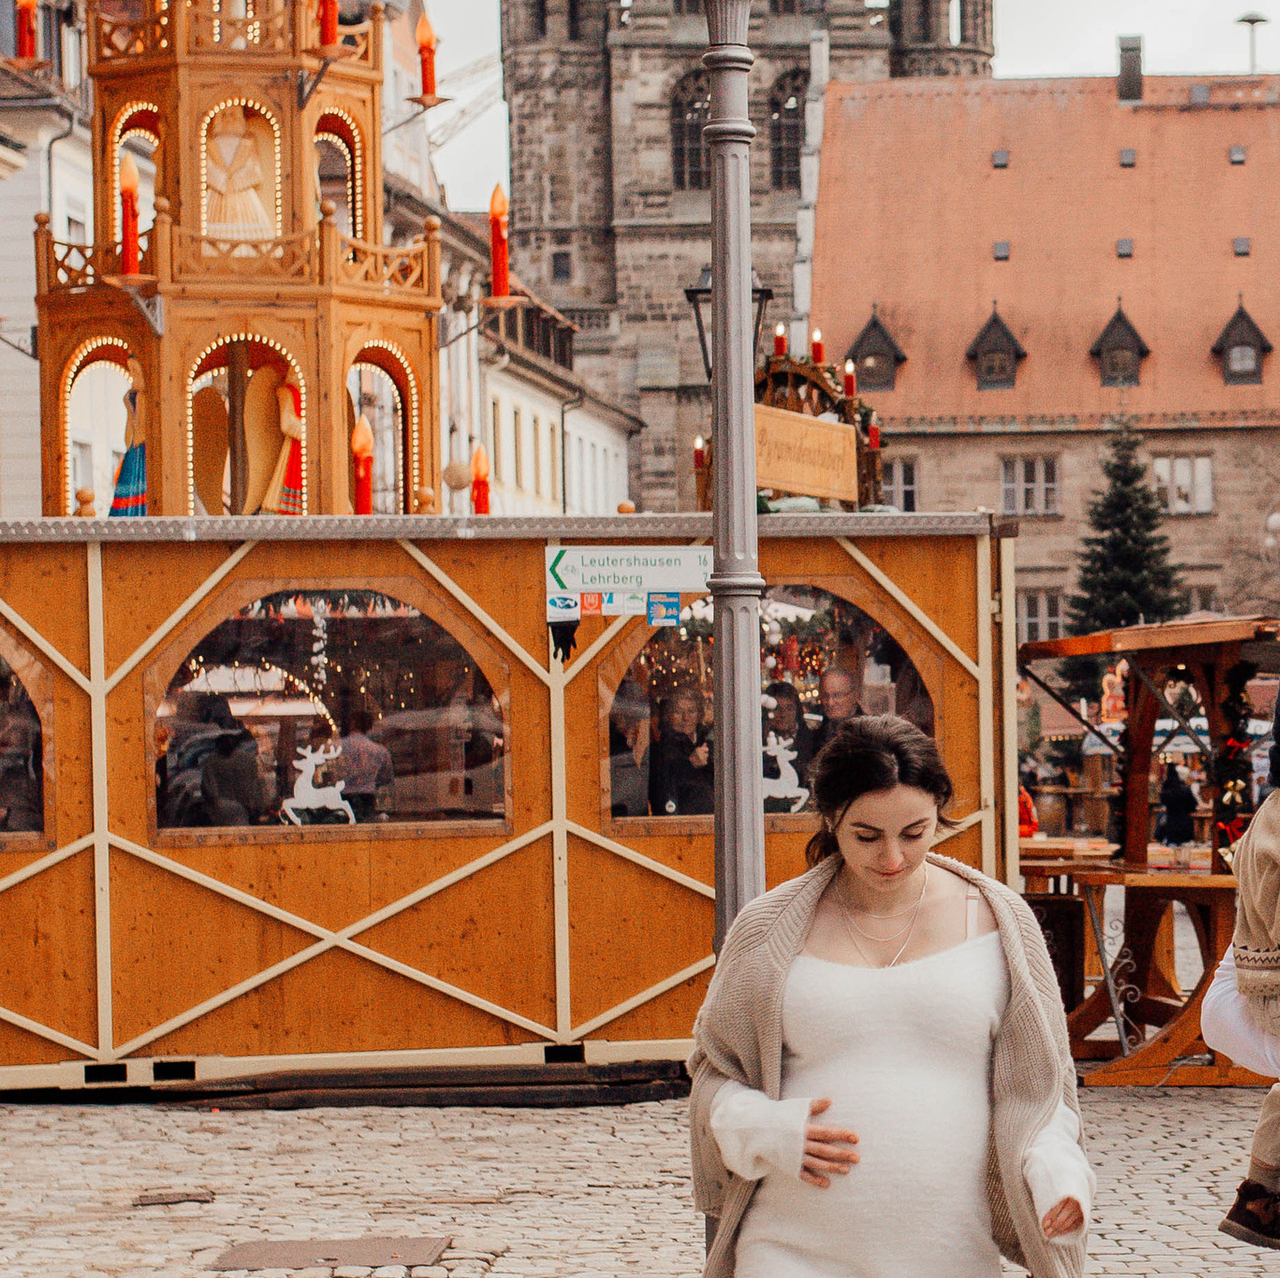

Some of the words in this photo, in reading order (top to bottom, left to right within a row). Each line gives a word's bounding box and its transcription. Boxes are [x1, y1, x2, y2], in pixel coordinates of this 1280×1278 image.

[581, 554, 682, 567] Leutershausen
[698, 554, 708, 567] 16
[581, 573, 643, 587] Lehrberg
